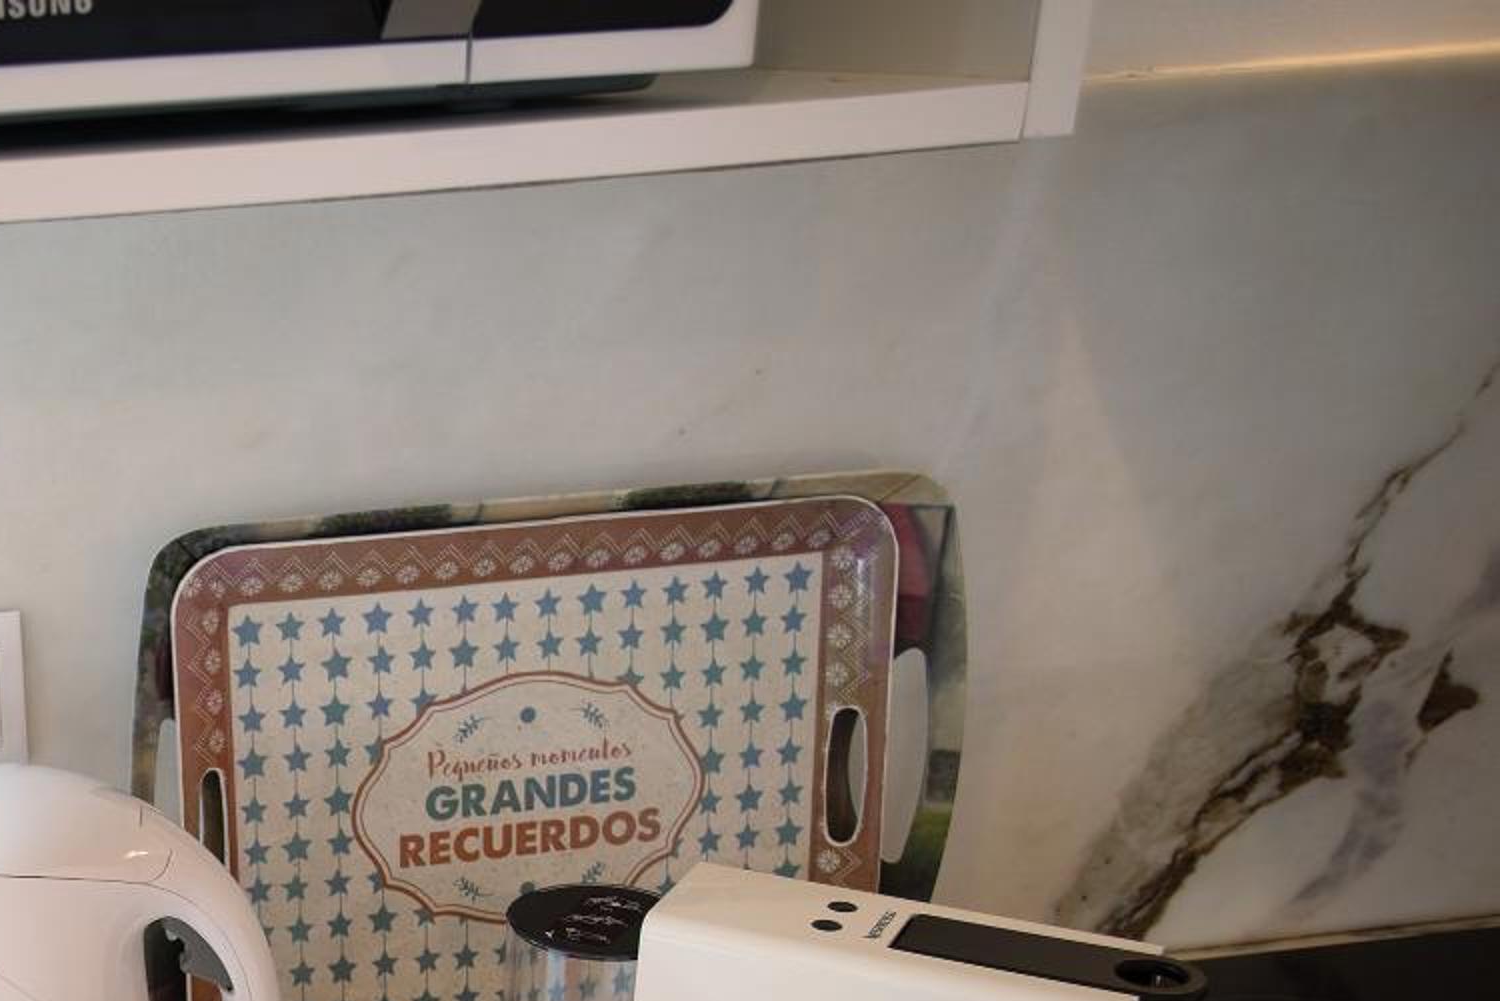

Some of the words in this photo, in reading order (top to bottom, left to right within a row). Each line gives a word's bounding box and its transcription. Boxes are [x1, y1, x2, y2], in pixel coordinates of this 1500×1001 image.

[426, 746, 523, 783] Pequeños
[530, 737, 633, 768] momentos
[425, 766, 637, 822] GRANDES
[400, 807, 662, 869] RECUERDOS
